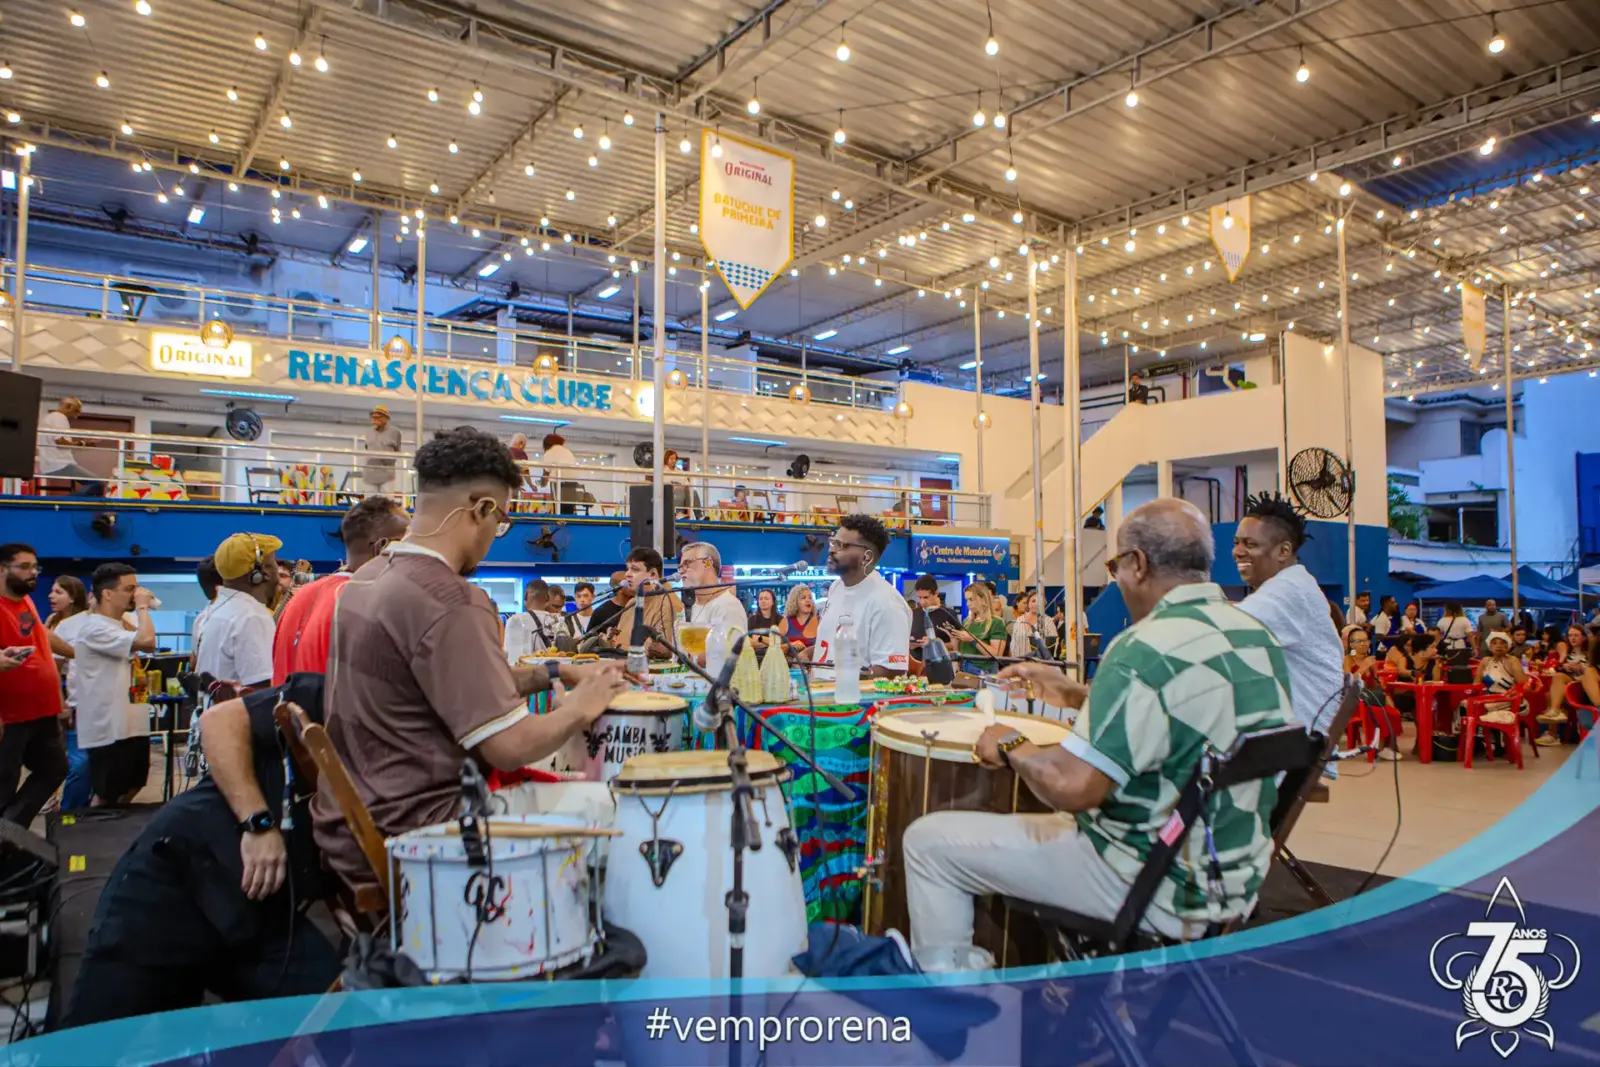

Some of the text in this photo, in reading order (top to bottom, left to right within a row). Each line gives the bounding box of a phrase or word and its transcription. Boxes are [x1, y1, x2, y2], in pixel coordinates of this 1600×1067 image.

[725, 162, 772, 186] ORIGINAL
[714, 192, 781, 221] BATUQUE DE
[722, 206, 775, 231] PRIMEIRA
[159, 344, 243, 367] ORIGINAL
[288, 350, 612, 410] RENASCENÇA CLUBE
[933, 545, 954, 555] Centro
[954, 546, 962, 556] de
[606, 724, 647, 745] SAMBA
